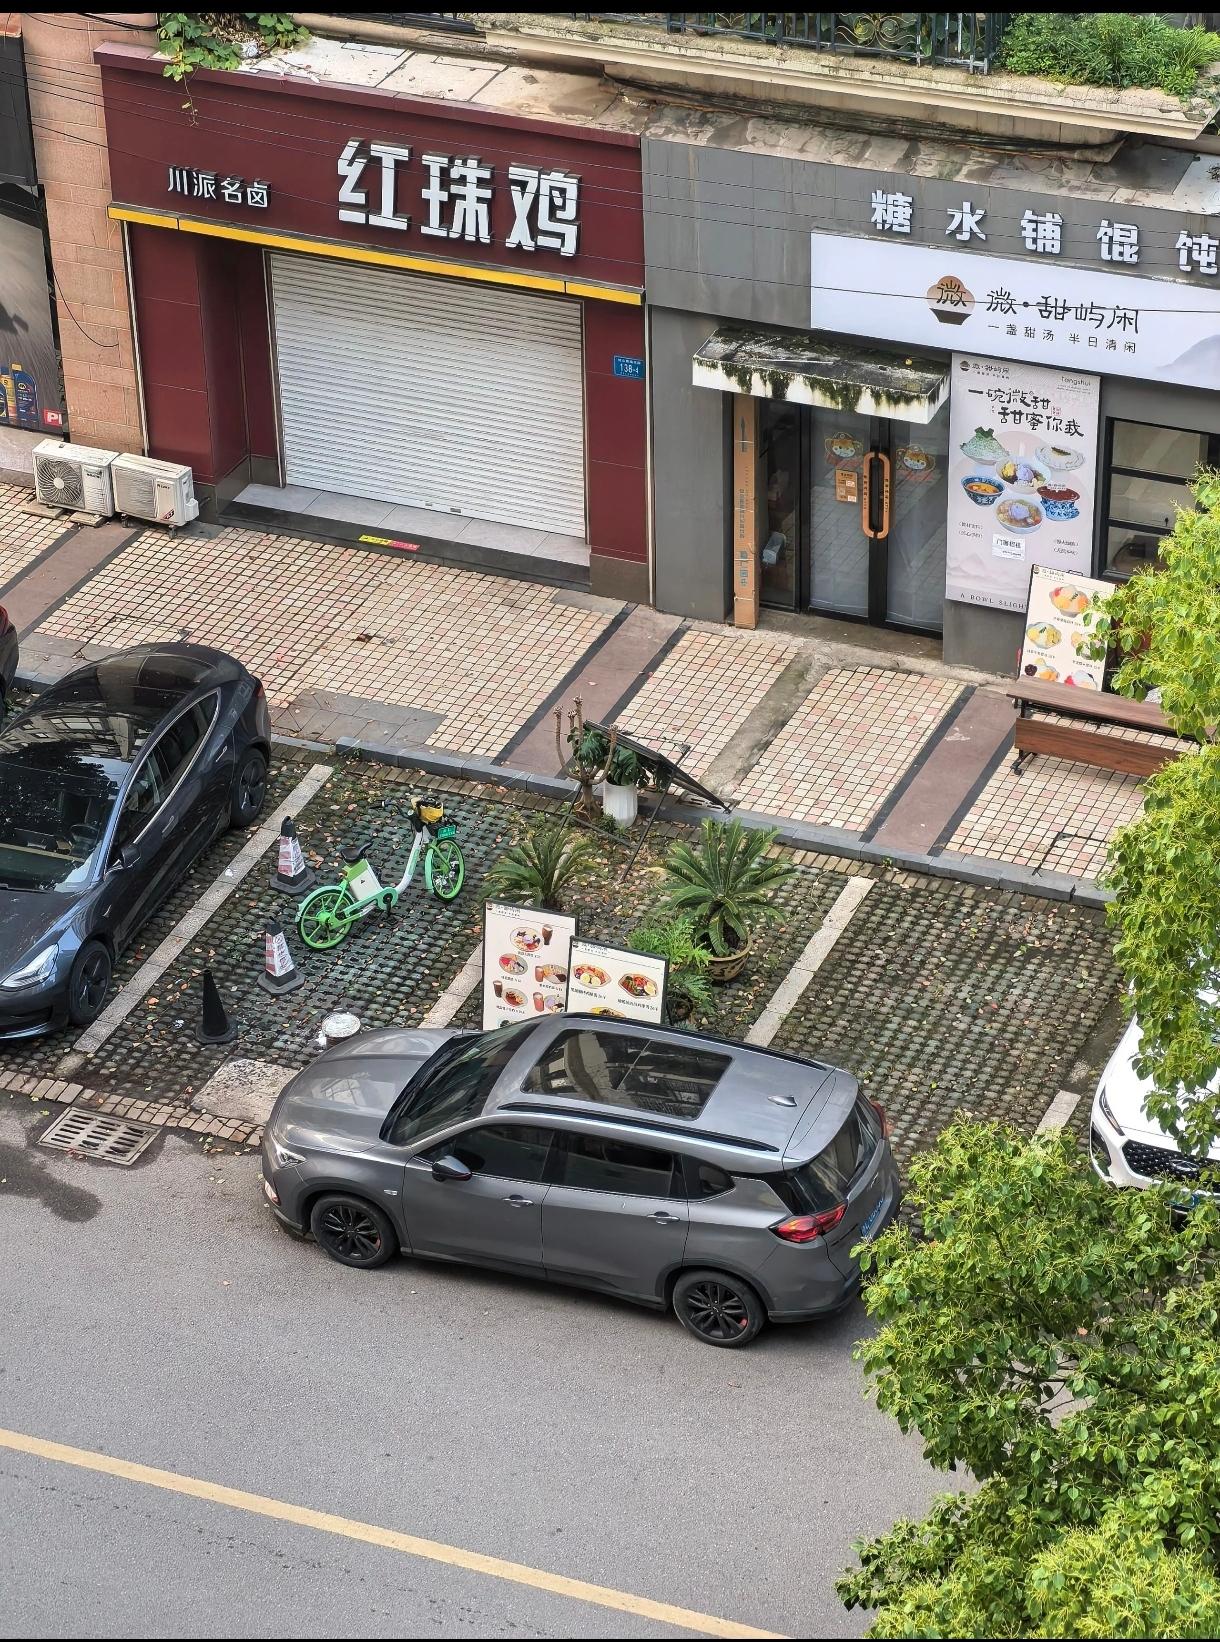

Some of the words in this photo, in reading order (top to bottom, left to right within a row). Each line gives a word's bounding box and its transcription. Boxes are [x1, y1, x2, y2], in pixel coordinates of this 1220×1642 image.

[167, 166, 269, 208] 川派名卤
[337, 138, 580, 257] 红珠鸡
[870, 189, 1219, 275] 糖水铺馄饨
[987, 323, 1055, 342] 一盏甜汤
[1068, 332, 1137, 354] 半日清闲
[998, 406, 1085, 438] 甜蜜你我
[970, 593, 994, 604] BOWL
[998, 600, 1027, 611] SLIGH
